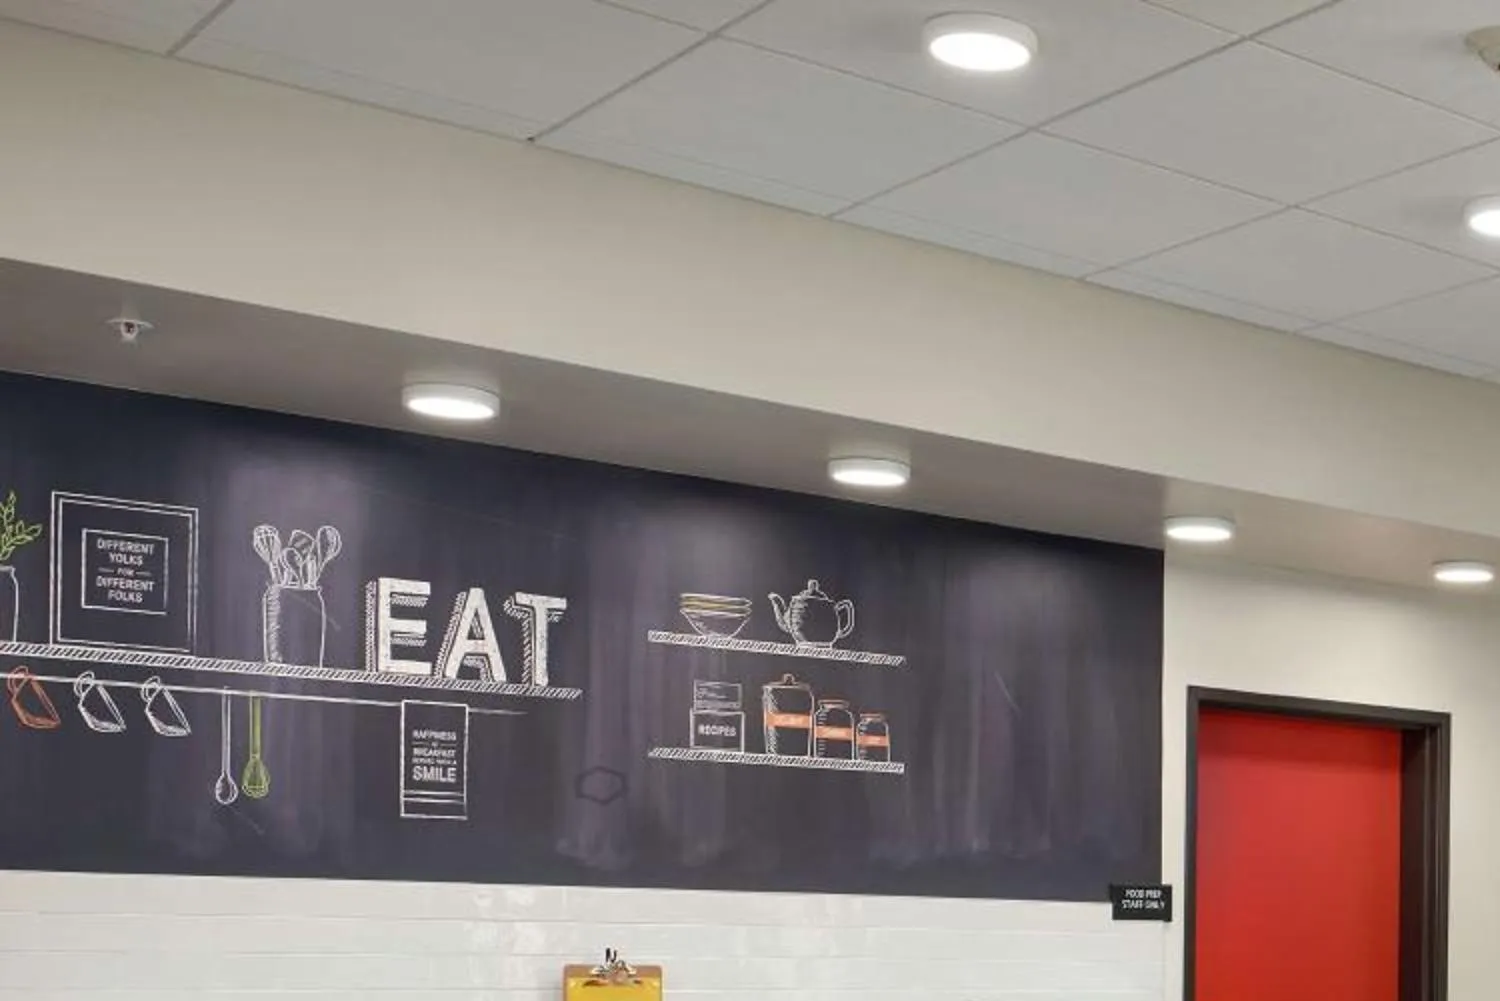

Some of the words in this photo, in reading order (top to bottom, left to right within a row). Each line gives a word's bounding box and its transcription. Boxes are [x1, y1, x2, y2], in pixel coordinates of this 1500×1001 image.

[97, 538, 154, 555] DIFFERENT
[109, 552, 143, 567] YOLKS
[96, 575, 154, 592] DIFFERENT
[108, 589, 143, 603] FOLKS
[366, 577, 567, 687] EAT
[412, 765, 457, 782] SMILE
